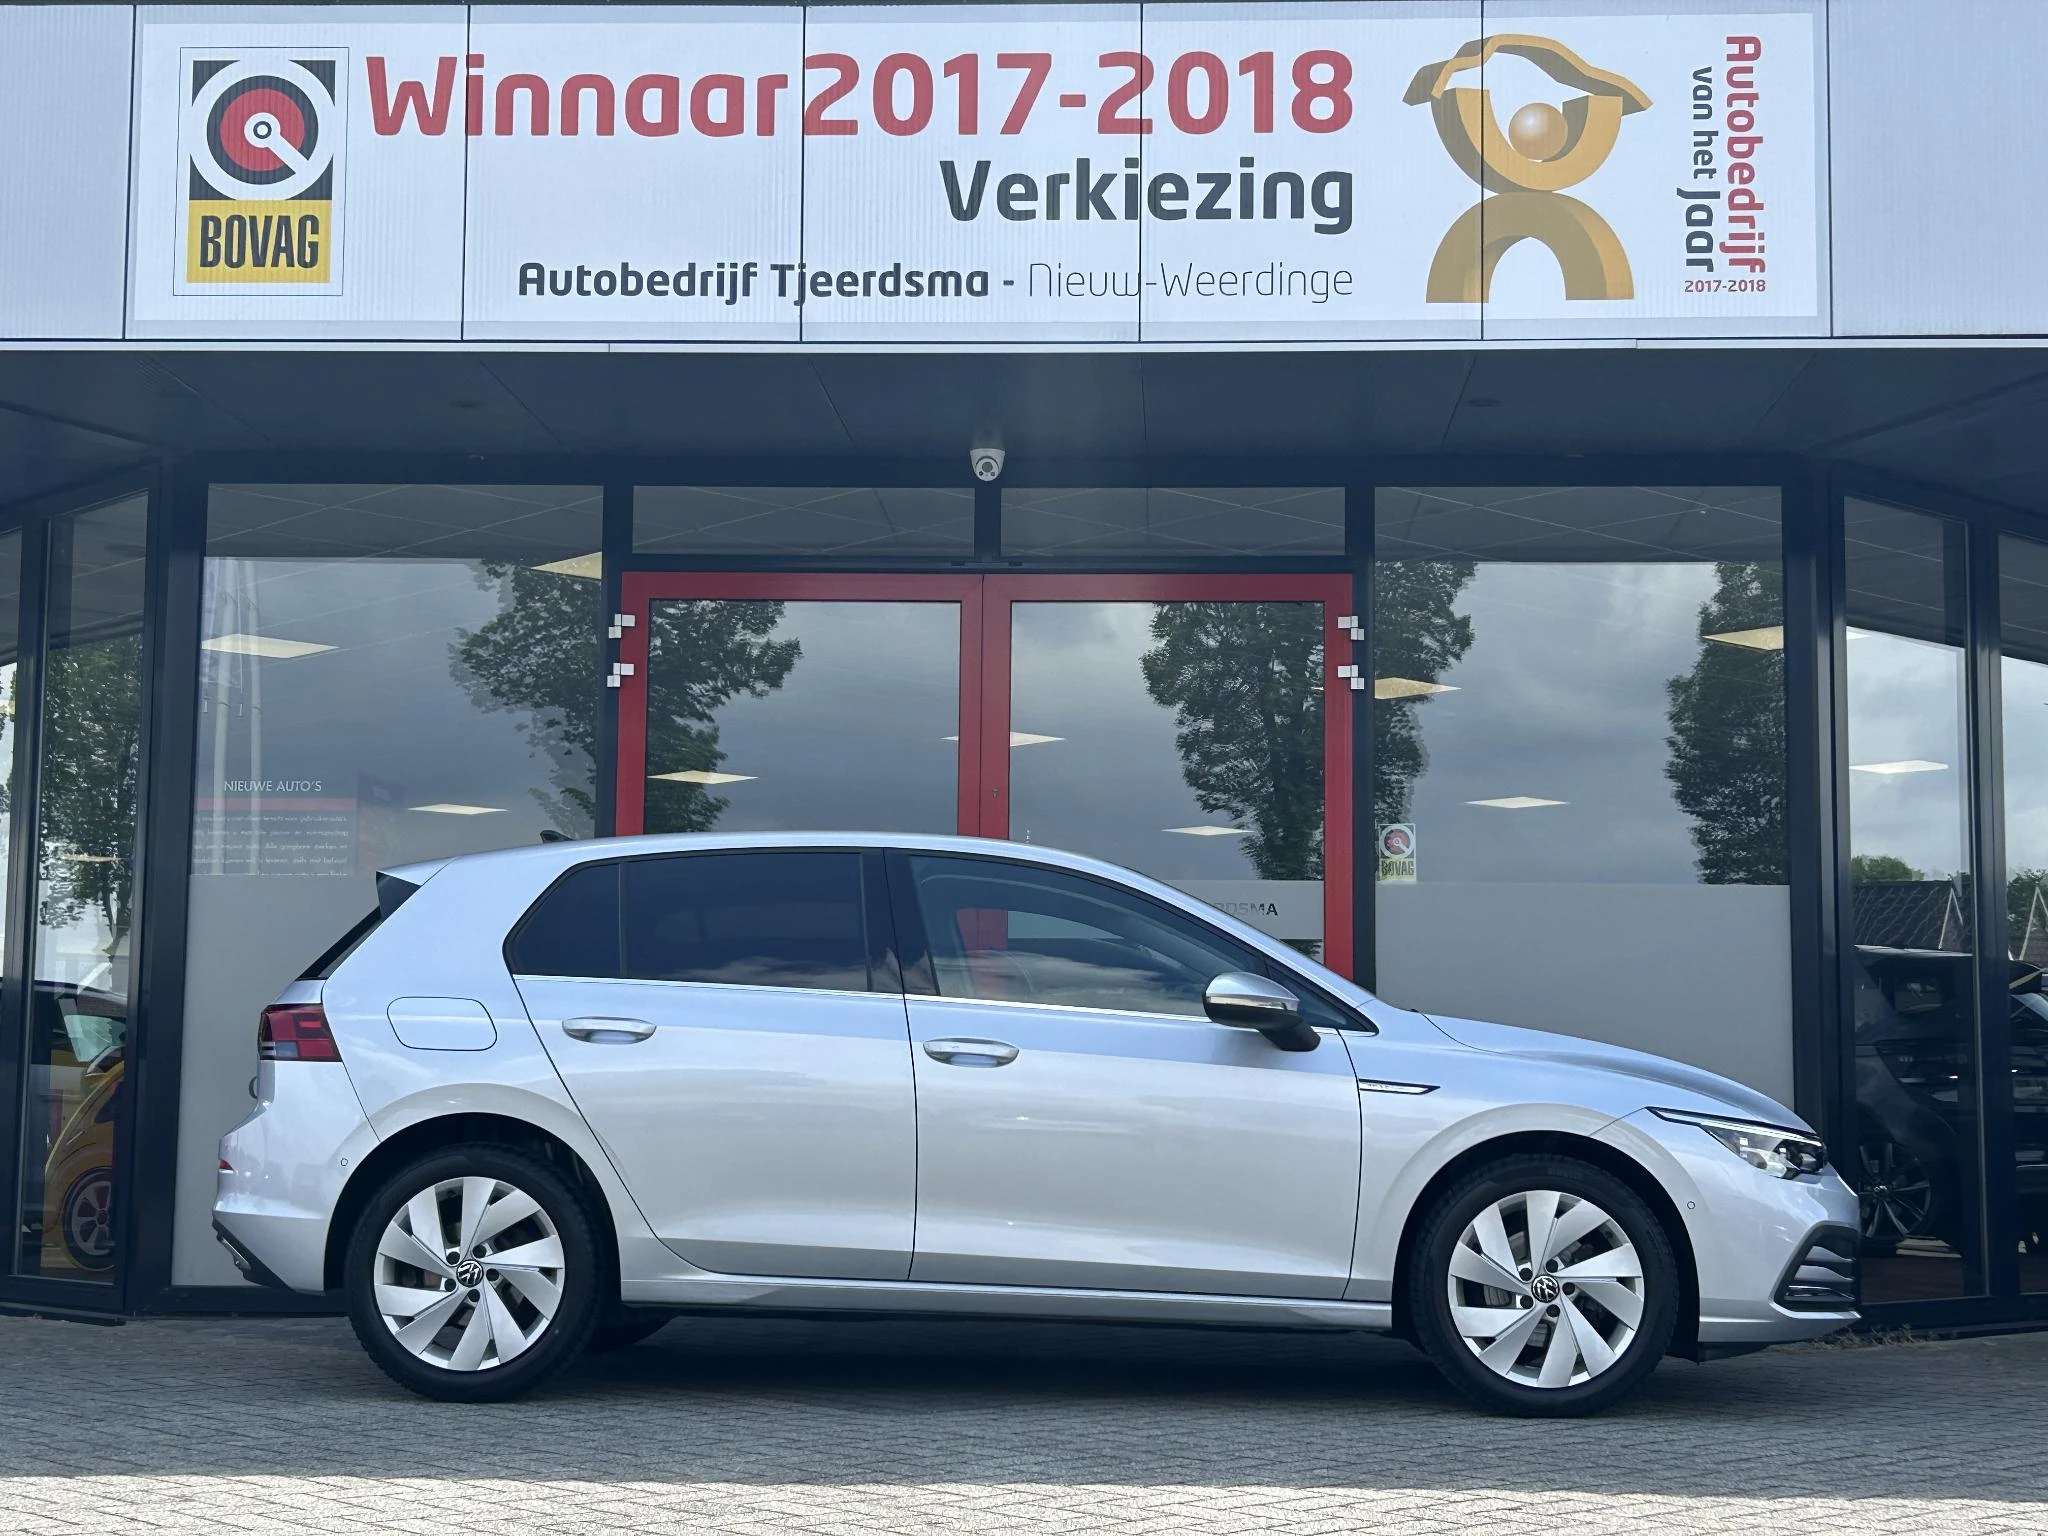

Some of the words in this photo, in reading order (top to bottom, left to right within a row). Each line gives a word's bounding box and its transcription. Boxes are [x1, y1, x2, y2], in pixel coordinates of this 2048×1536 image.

[367, 54, 788, 137] Winnaar
[803, 50, 1354, 136] 2017-2018
[1692, 65, 1713, 120] van
[1693, 130, 1719, 180] het
[1719, 36, 1766, 273] Autobedrijf
[939, 156, 1354, 235] Verkiezing
[199, 214, 320, 269] BOVAG
[1676, 187, 1721, 273] Jaar
[518, 262, 758, 306] Autobedrijf
[770, 261, 989, 306] Tjeerdsma
[1029, 261, 1354, 304] Nieuw-Weerdinge
[1684, 279, 1766, 293] 2017-2018
[224, 780, 273, 792] NIEUWE
[276, 780, 322, 792] AUTO'S
[1381, 860, 1416, 876] BOVAG
